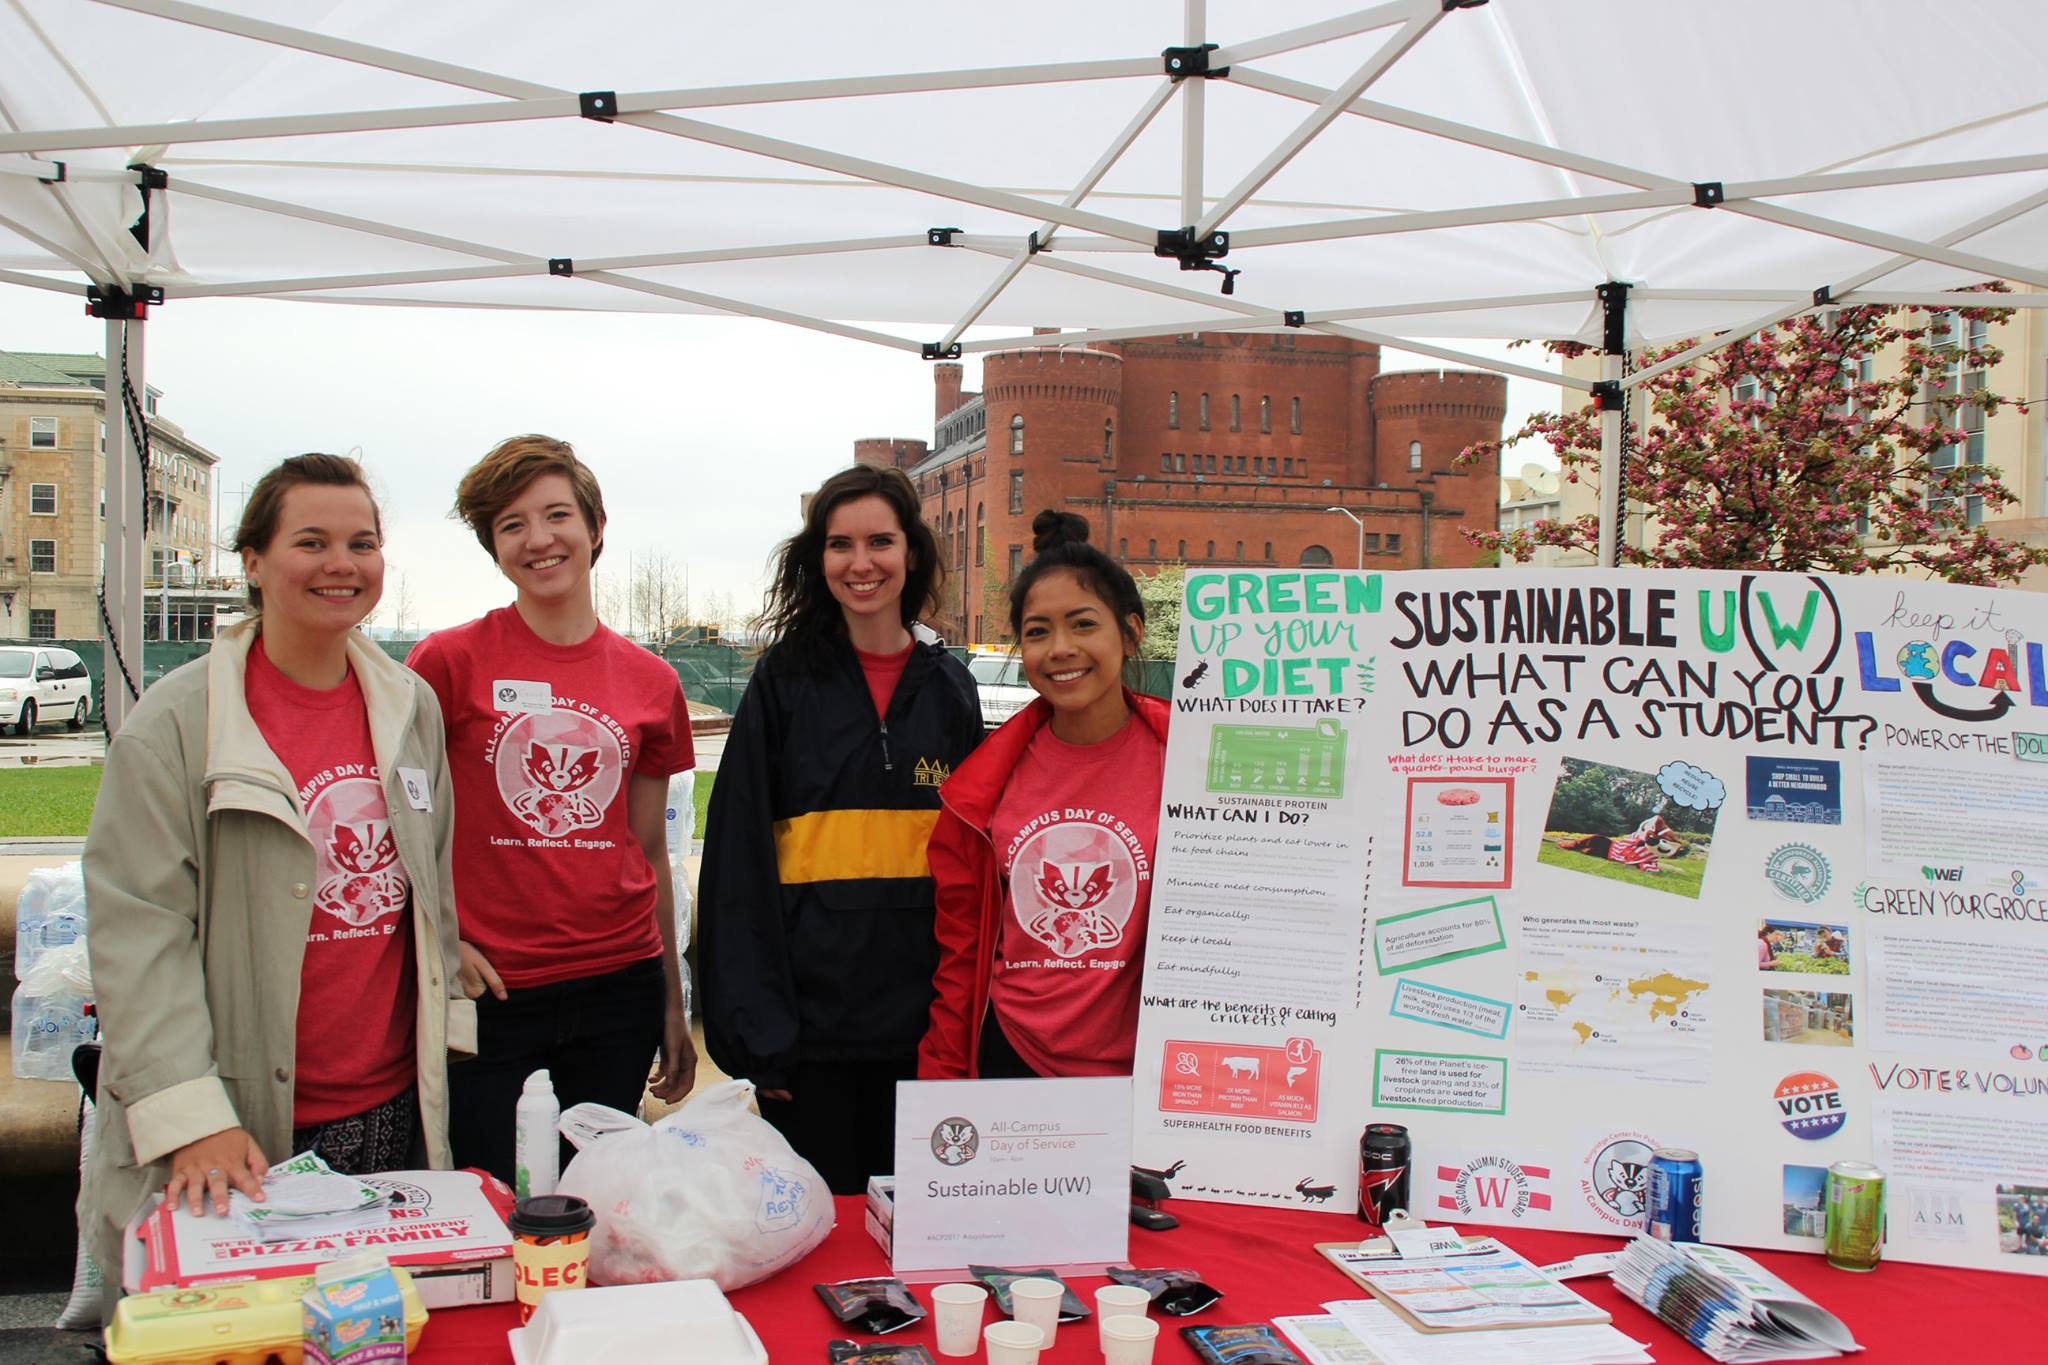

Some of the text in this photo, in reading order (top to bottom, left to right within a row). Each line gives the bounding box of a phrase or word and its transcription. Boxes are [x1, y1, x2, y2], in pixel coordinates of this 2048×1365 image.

[1186, 573, 1383, 620] GREEN
[1390, 575, 1842, 674] SUSTAINABLE U(W)
[1881, 590, 2006, 641] keep it
[1223, 657, 1350, 698] DIET
[1402, 652, 1844, 715] WHAT CAN YOU
[1177, 697, 1232, 713] WHAT
[1240, 699, 1277, 713] DOES
[1402, 698, 1878, 751] DO AS A STUDENT?
[579, 703, 599, 716] OF
[600, 713, 632, 768] SERVICE
[1885, 723, 1950, 751] POWER
[1950, 734, 1972, 751] OF
[1972, 734, 2011, 755] THE
[1388, 753, 1537, 764] What does take to make
[336, 764, 364, 776] DAY
[1218, 796, 1328, 810] SUSTAINABLE PROTEIN
[1167, 803, 1310, 827] WHAT CAN I DO?
[490, 835, 615, 850] Learn. Reflect. Engage.
[1065, 808, 1150, 881] DAY OF SERVICE
[1174, 831, 1349, 849] Prioritize plants and eat lower in
[1171, 845, 1187, 854] the
[1190, 846, 1212, 857] food
[1167, 878, 1220, 890] Minimize
[1224, 881, 1250, 891] meat
[1769, 871, 1809, 899] CERTIFIED
[1164, 905, 1183, 915] Eat
[1864, 886, 1935, 915] GREEN
[1939, 891, 1985, 920] YOUR
[1522, 915, 1640, 929] Who generates the most waste?
[333, 926, 379, 941] Reflect.
[1161, 934, 1200, 945] Keep it
[1385, 929, 1426, 943] Agriculture
[1427, 923, 1461, 935] accounts
[1405, 933, 1454, 948] deforestation
[1006, 960, 1041, 969] Learn.
[1157, 962, 1241, 978] Eat mindfully:
[1401, 983, 1477, 1010] Livestock production
[1143, 996, 1336, 1027] What are the benefits of eating
[1431, 1010, 1450, 1020] fresh
[1451, 1016, 1473, 1026] water
[1443, 1005, 1460, 1014] uses
[1475, 1012, 1483, 1021] of
[1484, 1016, 1496, 1025] the
[1396, 1057, 1413, 1066] 26%
[1424, 1059, 1437, 1067] the
[1439, 1060, 1471, 1069] Planet's
[1383, 1075, 1421, 1084] livestock
[1422, 1078, 1452, 1088] grazing
[1454, 1080, 1470, 1088] and
[1401, 1067, 1482, 1079] free land used for
[1868, 1063, 1953, 1093] VOTE
[1956, 1070, 1971, 1090] &
[1380, 1093, 1483, 1108] livestock feed production
[1394, 1085, 1487, 1098] croplands are used for
[1778, 1092, 1842, 1116] VOTE
[990, 1120, 1061, 1134] All-Campus
[1163, 1119, 1312, 1139] SUPERHEALTH FOOD BENEFITS
[990, 1137, 1076, 1154] Day of Service
[927, 1176, 1091, 1198] Sustainable U(W)
[1455, 1156, 1529, 1218] WISCONSIN ALUMNI STUDENT BOARD
[1474, 1176, 1512, 1208] W
[1586, 1195, 1620, 1225] Campus
[1623, 1218, 1643, 1229] Day
[361, 1219, 468, 1235] PIZZA COMPANY
[229, 1226, 471, 1258] PIZZA FAMILY
